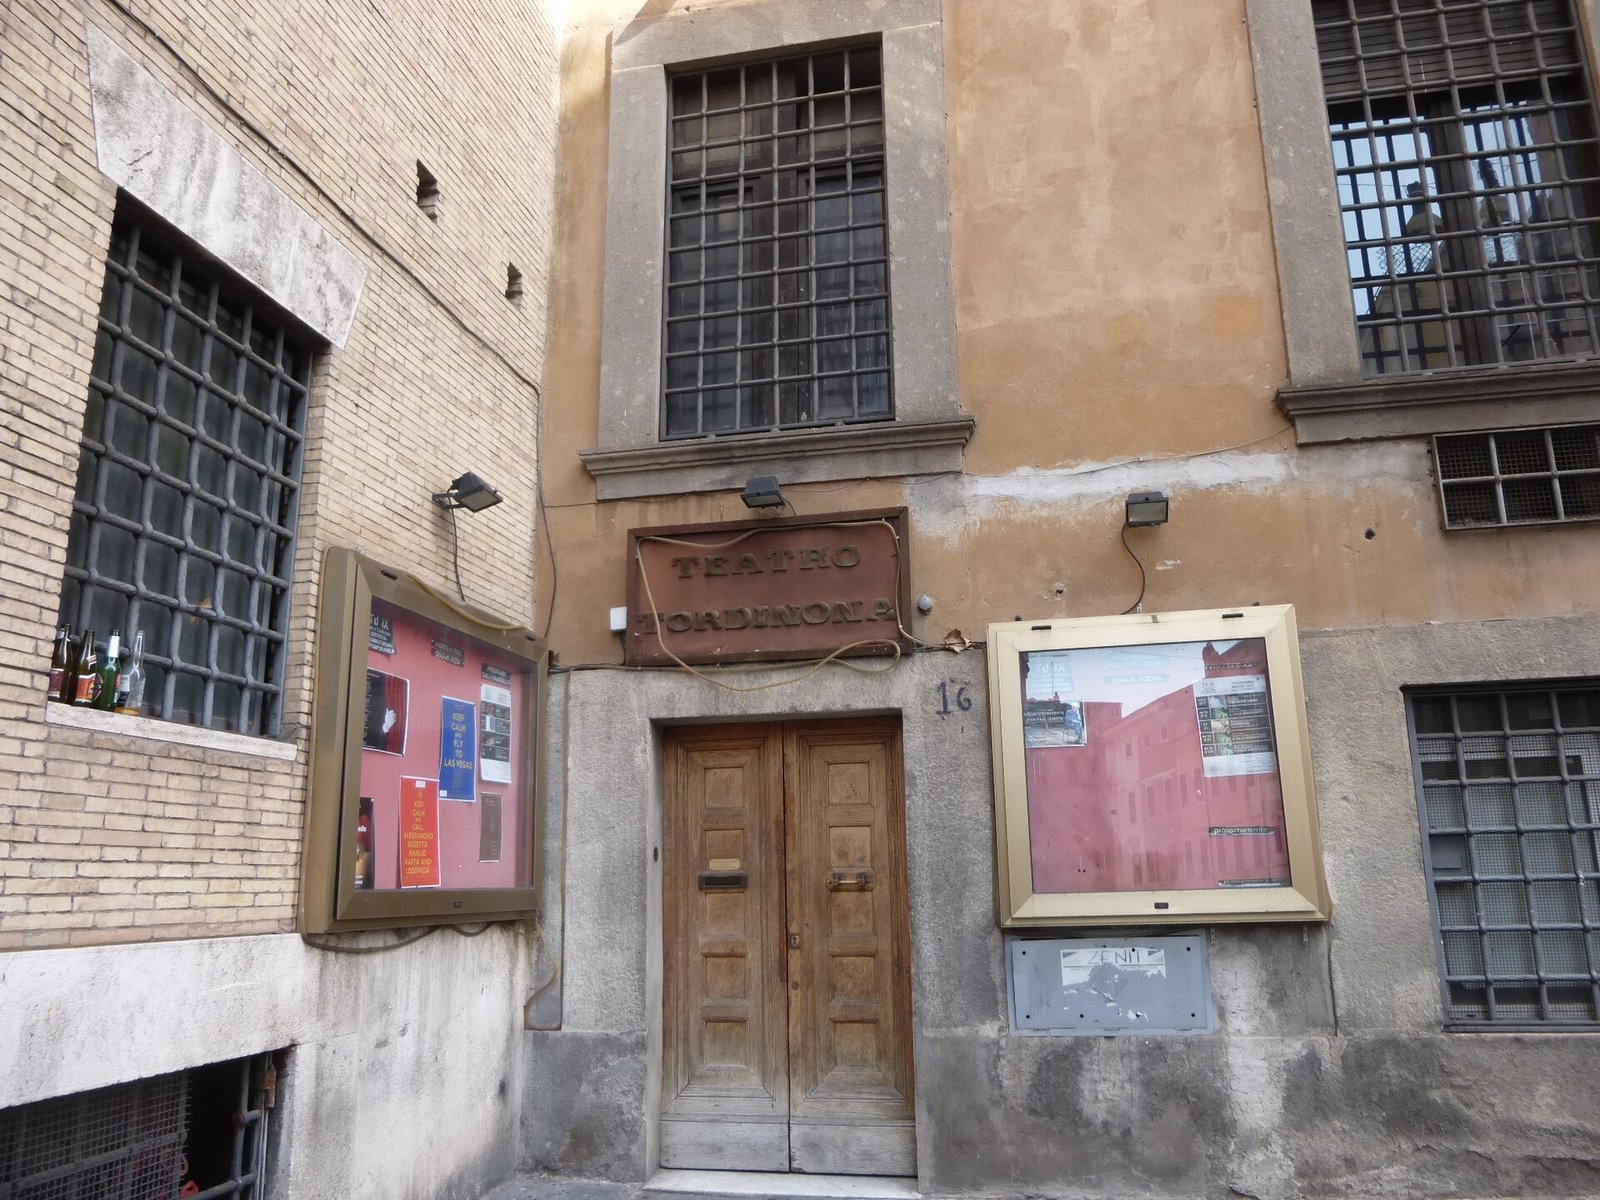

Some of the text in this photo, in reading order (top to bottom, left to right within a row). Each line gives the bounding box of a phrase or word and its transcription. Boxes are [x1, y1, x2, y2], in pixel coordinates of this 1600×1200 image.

[672, 545, 861, 579] TEATRO
[636, 597, 896, 635] TORDINONA
[936, 681, 972, 715] 16
[451, 723, 465, 732] CALM
[453, 740, 464, 748] FLY
[455, 750, 463, 758] TO
[444, 759, 473, 769] LAS VEGAS
[403, 832, 433, 840] ALESSANDRO
